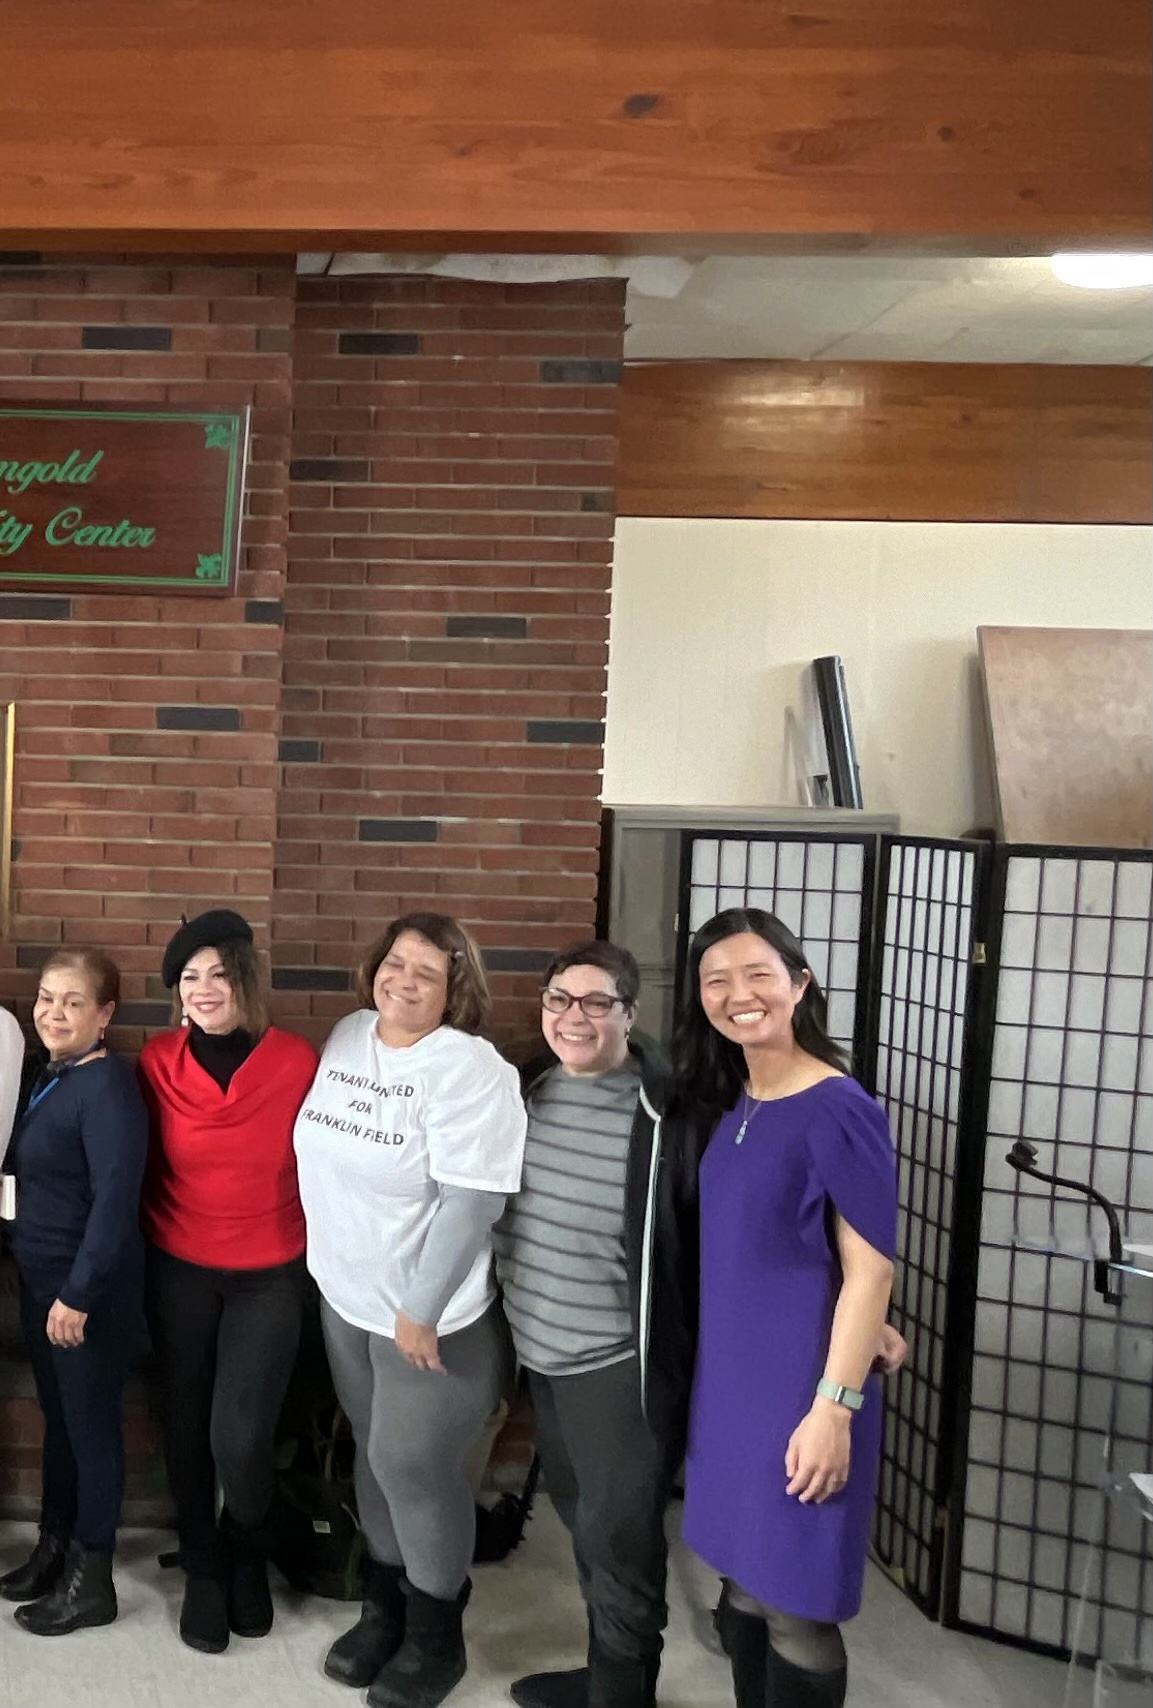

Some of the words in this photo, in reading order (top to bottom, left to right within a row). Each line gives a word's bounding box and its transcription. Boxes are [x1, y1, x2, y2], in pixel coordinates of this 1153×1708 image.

[45, 506, 157, 549] Center
[369, 1081, 415, 1098] UNTED
[347, 1099, 373, 1115] FOR
[301, 1108, 363, 1137] FRANKLIN
[362, 1127, 405, 1146] FIELD
